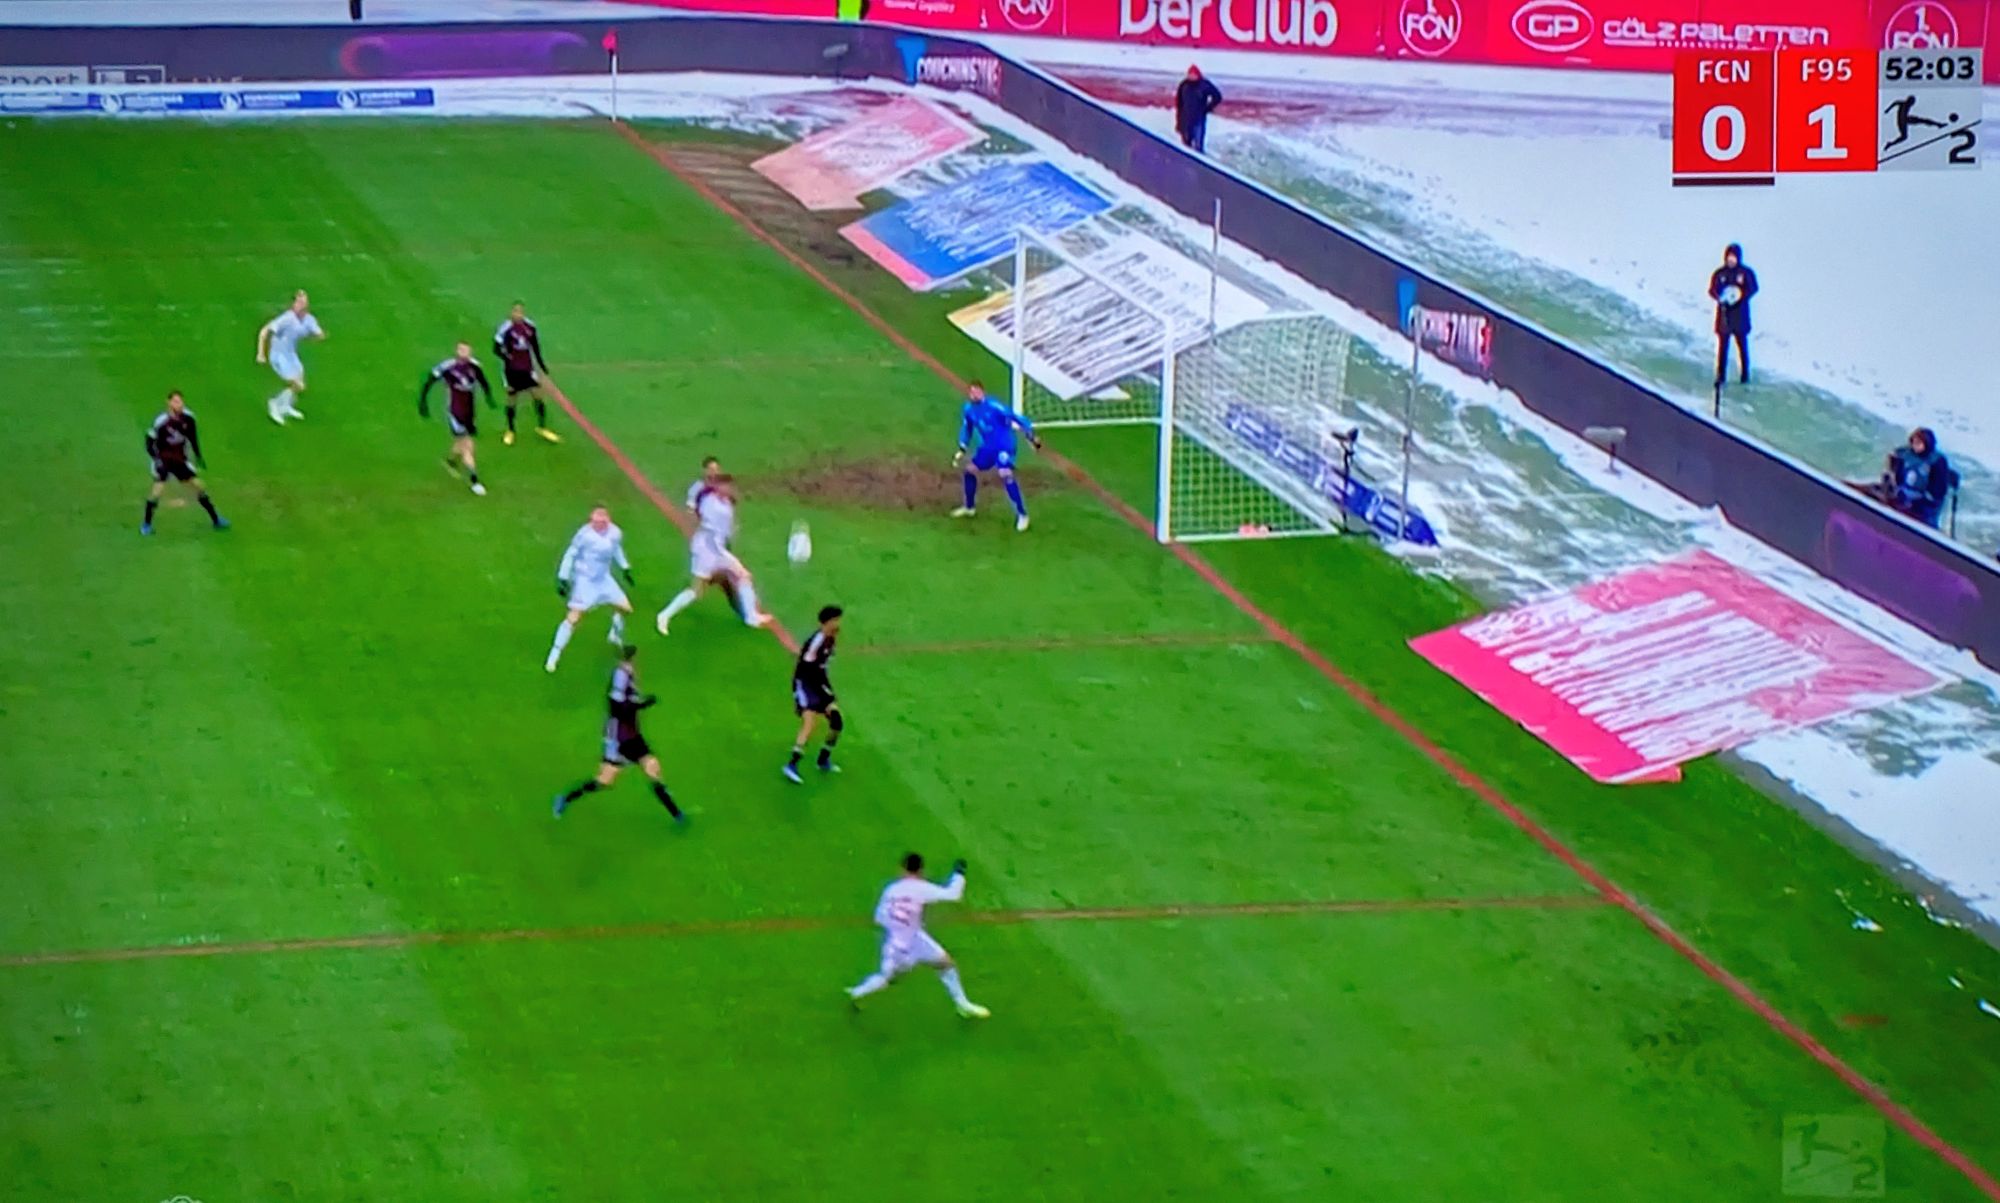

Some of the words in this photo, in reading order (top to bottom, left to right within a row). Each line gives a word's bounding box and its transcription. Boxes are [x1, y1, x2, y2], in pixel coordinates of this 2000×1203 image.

[1120, 0, 1211, 37] Der
[1219, 0, 1337, 46] Club
[1405, 14, 1454, 39] FCN
[1528, 14, 1579, 37] GP
[1603, 17, 1676, 39] GÖLZ
